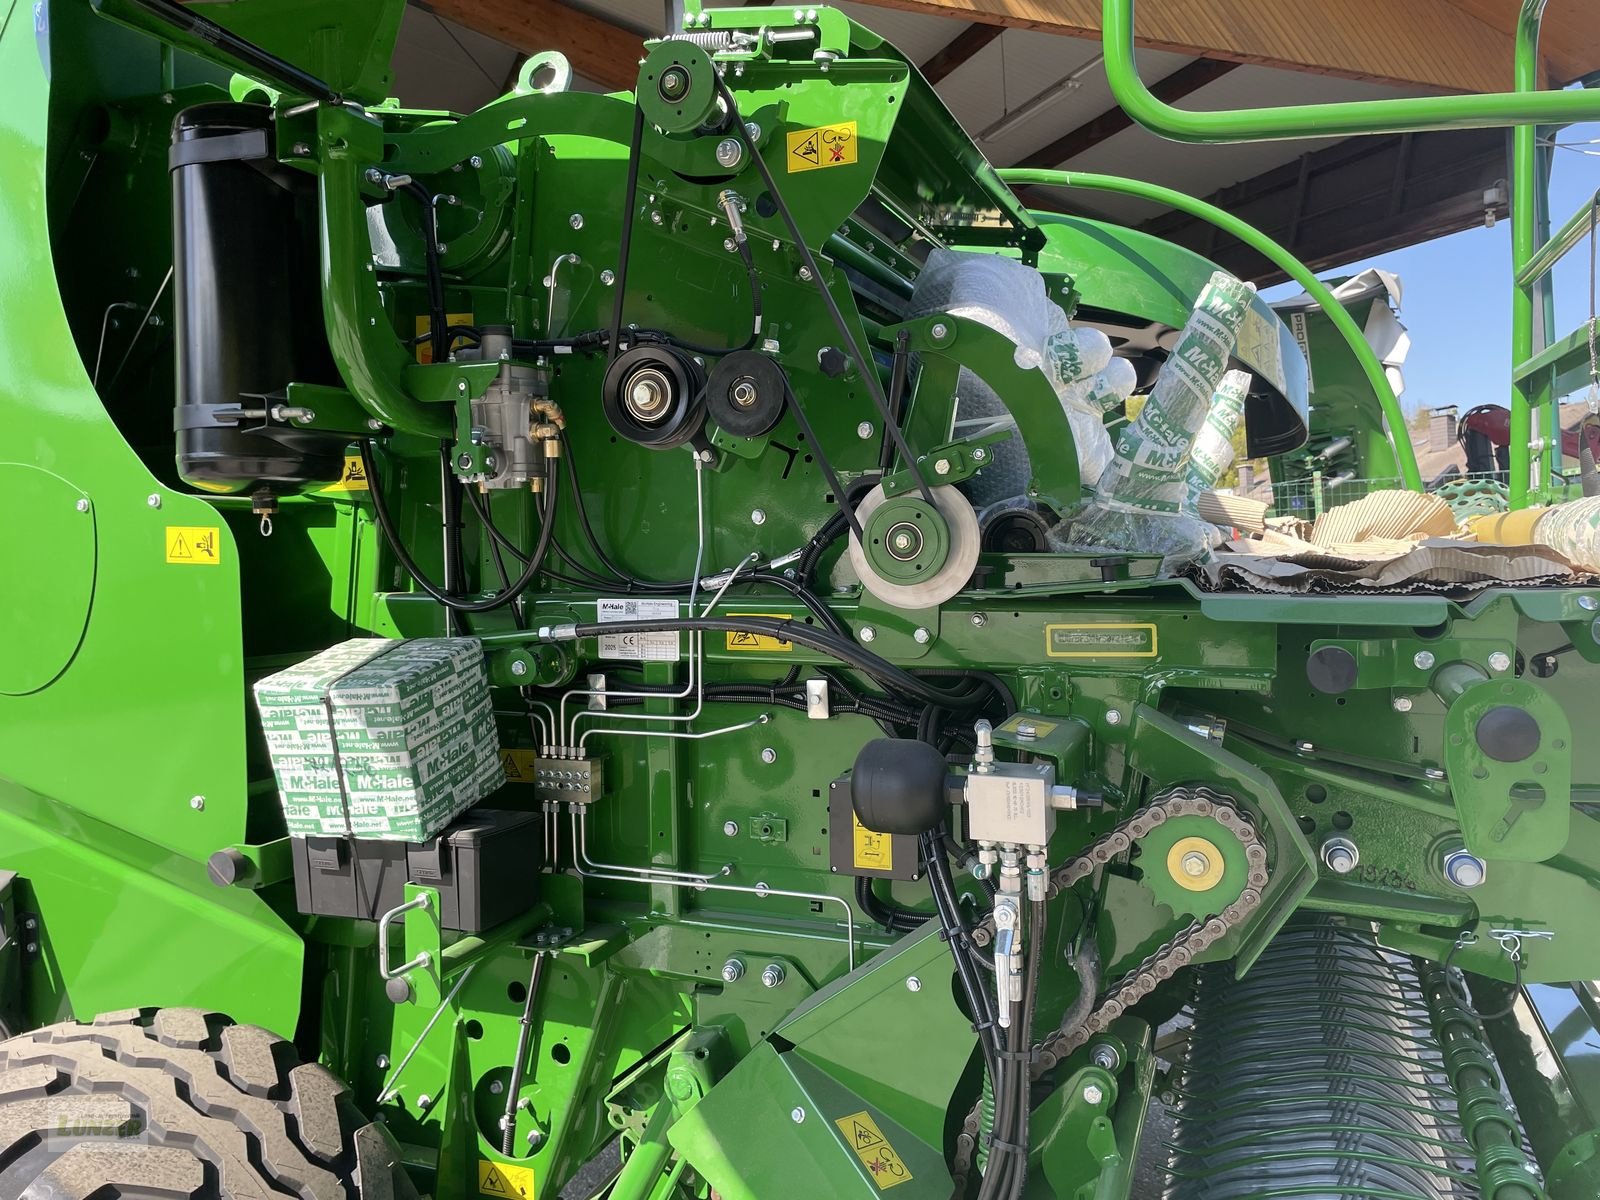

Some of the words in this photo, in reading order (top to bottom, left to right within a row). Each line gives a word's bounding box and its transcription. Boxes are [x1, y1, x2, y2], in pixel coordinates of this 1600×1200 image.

[623, 636, 634, 645] CE
[427, 741, 469, 778] McHale
[357, 774, 413, 789] McHale
